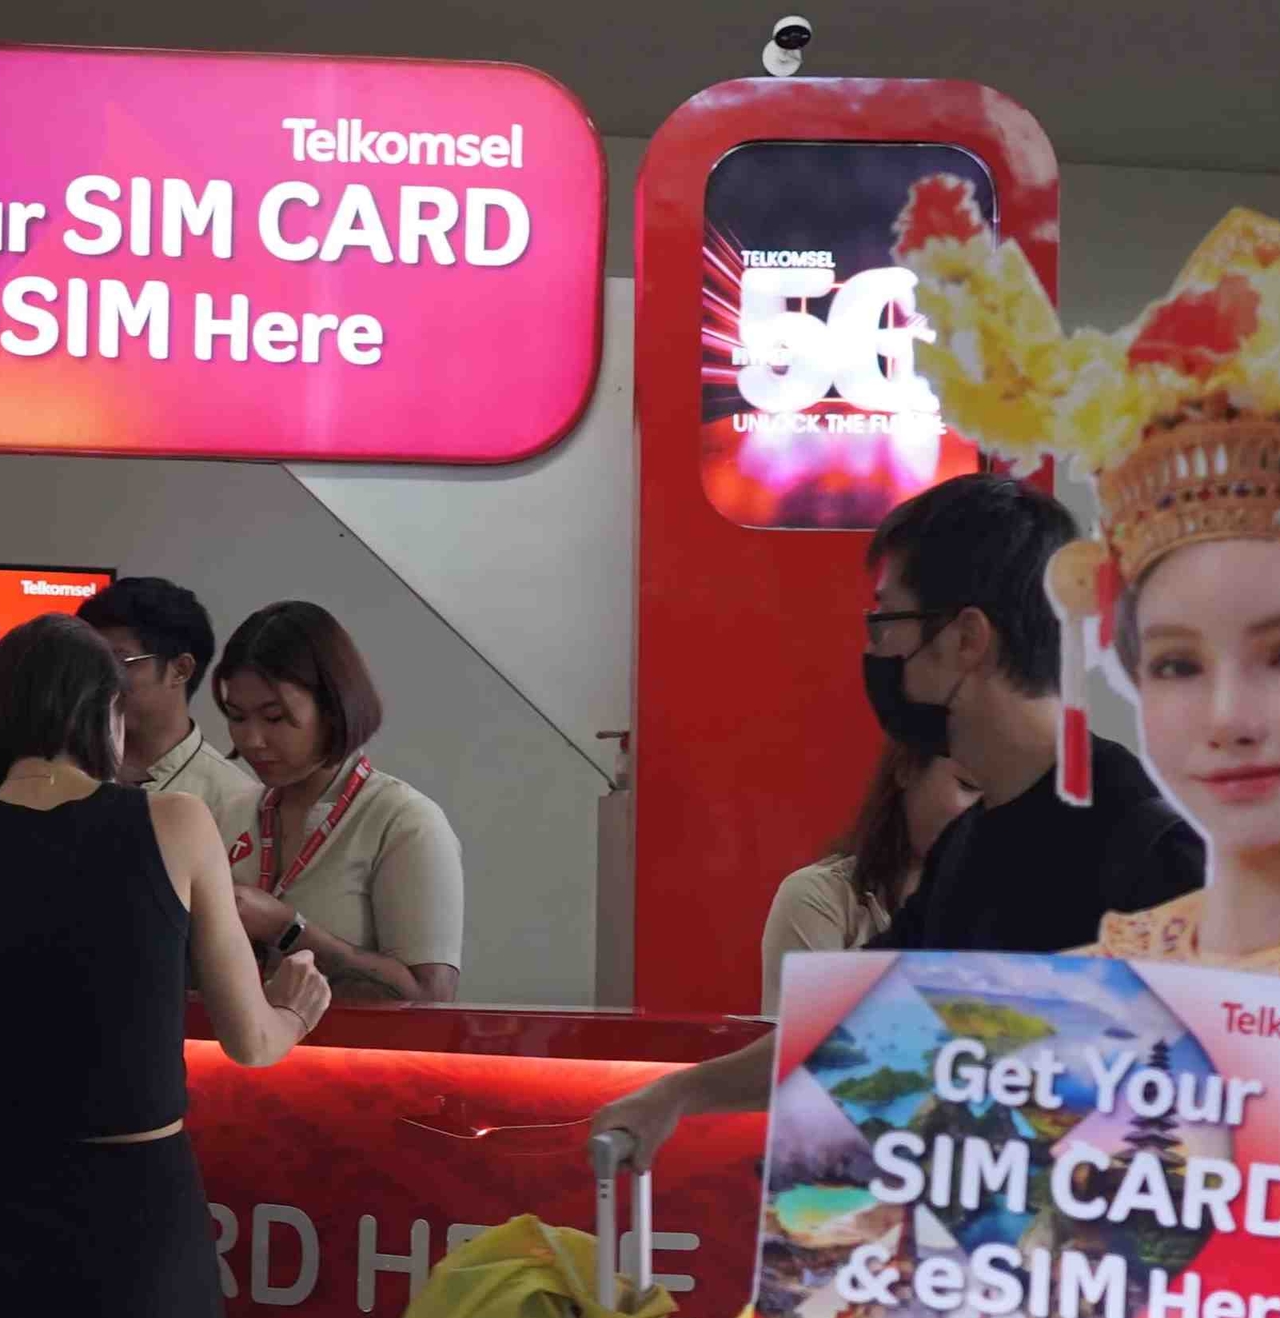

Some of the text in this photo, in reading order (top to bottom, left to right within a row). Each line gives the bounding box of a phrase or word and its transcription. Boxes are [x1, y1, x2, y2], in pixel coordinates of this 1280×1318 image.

[282, 119, 522, 168] Telkomsel
[62, 176, 232, 260] SIM
[258, 181, 530, 267] CARD
[741, 250, 835, 268] TELKOMSEL
[194, 294, 383, 365] Here
[825, 414, 866, 434] THE
[21, 580, 96, 598] Telkomsel
[934, 1038, 1265, 1126] Get Your
[869, 1132, 1029, 1212] SIM
[837, 1244, 899, 1307] &
